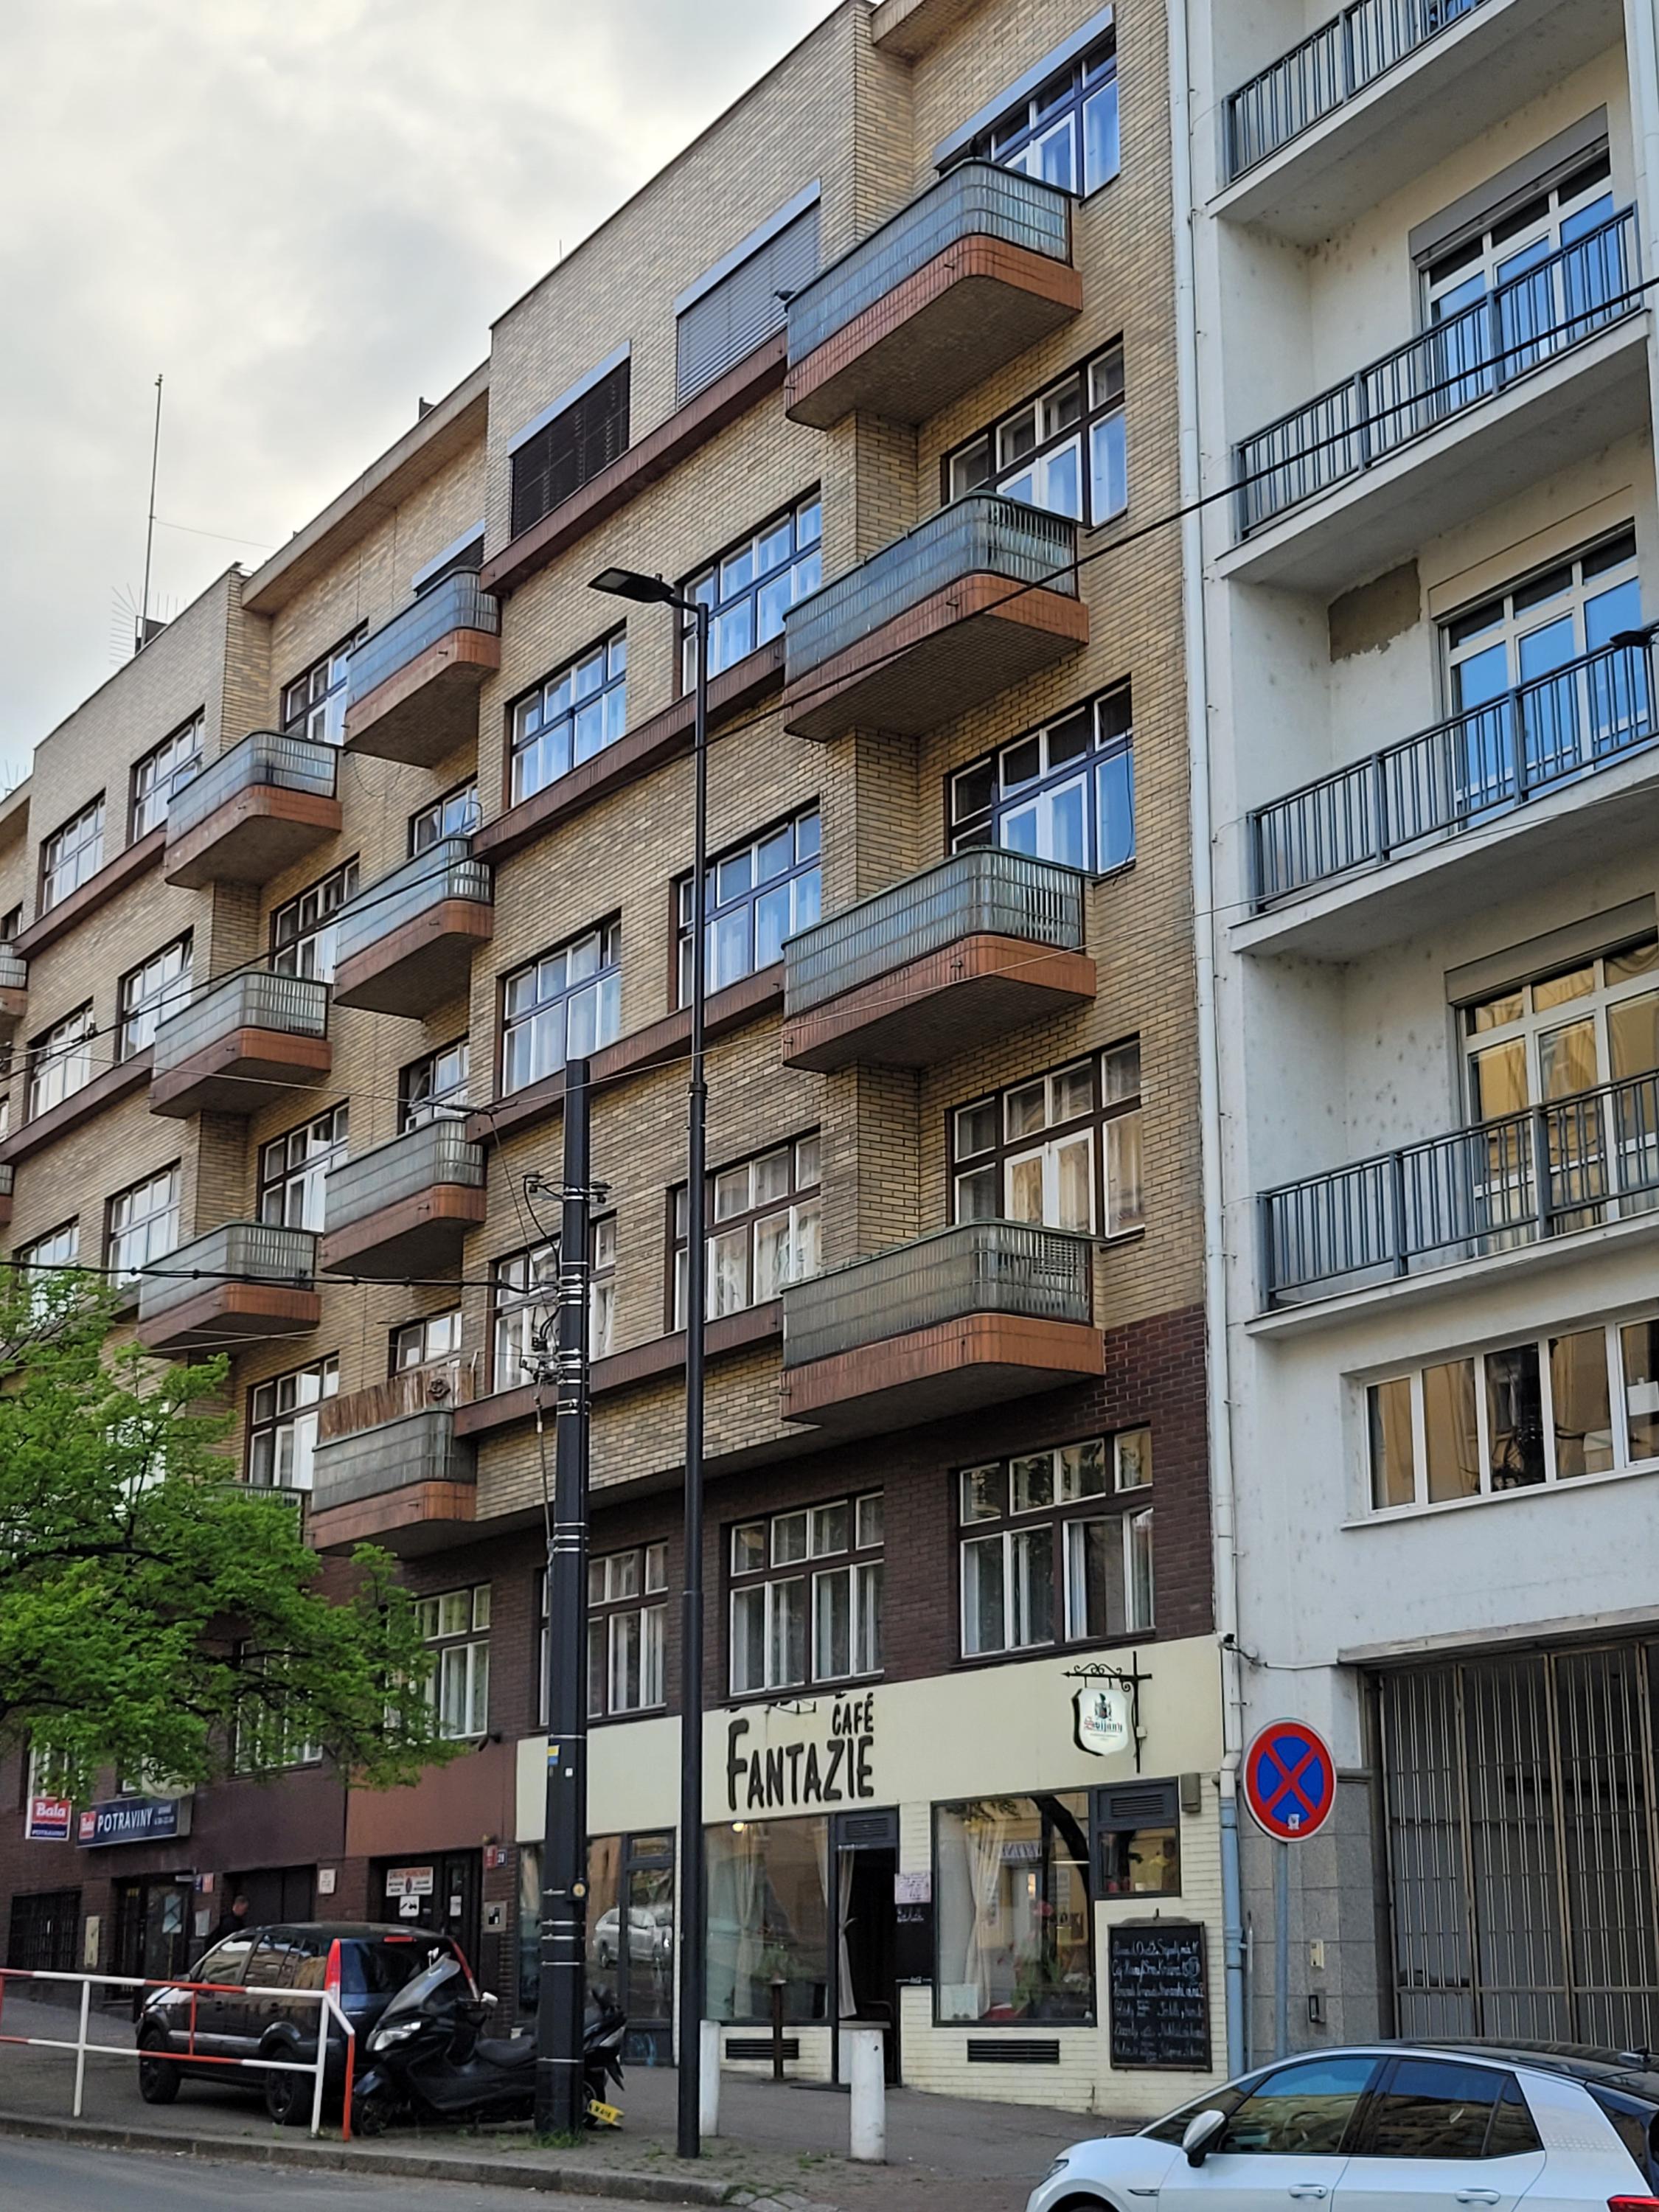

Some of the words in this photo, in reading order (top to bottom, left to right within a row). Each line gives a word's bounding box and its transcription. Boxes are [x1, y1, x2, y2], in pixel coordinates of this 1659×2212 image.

[832, 1692, 874, 1736] CAFÉ
[727, 1718, 874, 1812] FANTAZIE
[36, 1801, 66, 1818] Bala
[97, 1807, 153, 1833] POTRAVINY
